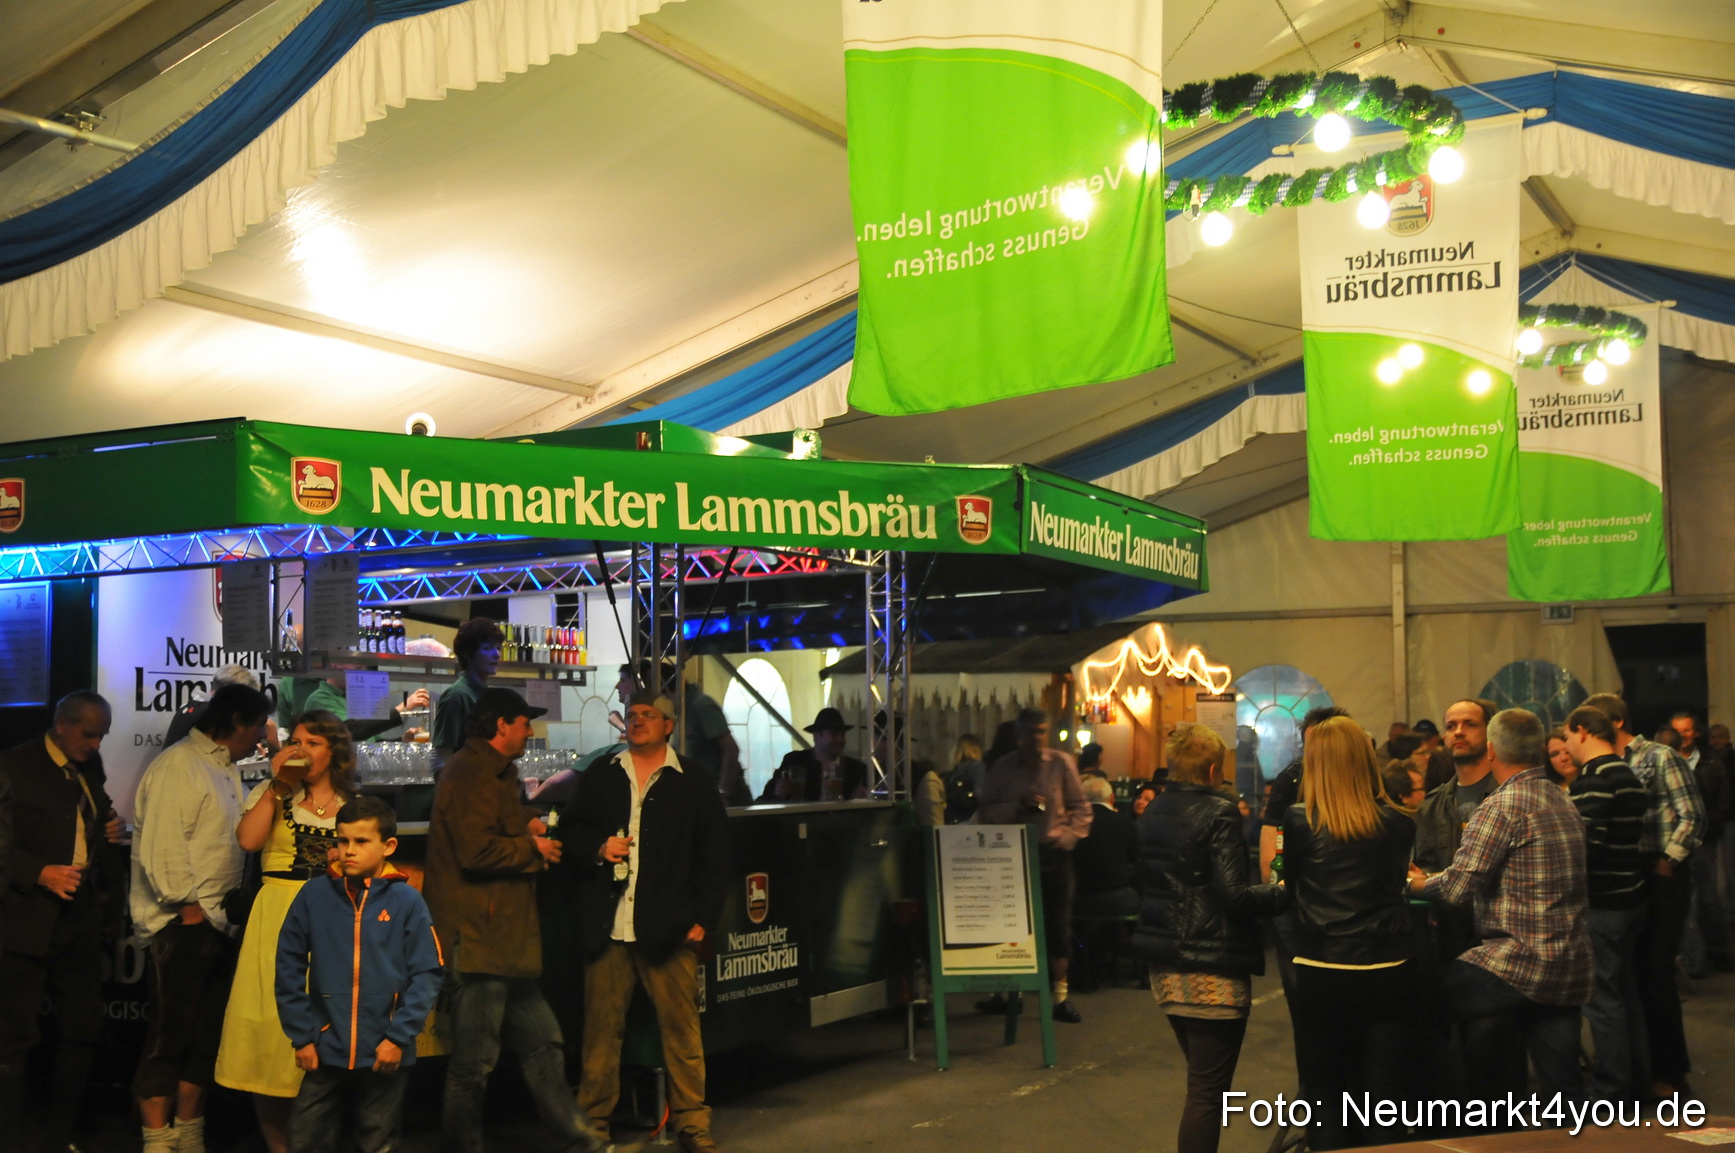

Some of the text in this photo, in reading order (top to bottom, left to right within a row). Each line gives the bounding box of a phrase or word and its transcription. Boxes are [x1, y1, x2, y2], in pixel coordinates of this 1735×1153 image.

[305, 498, 327, 509] 1628
[370, 466, 938, 540] Neumarkter Lammsbräu
[1029, 500, 1199, 580] Neumarkter Lammsbräu
[134, 733, 163, 747] DAS
[728, 925, 788, 951] Neumarkter
[716, 943, 798, 982] Lammsbräu
[717, 993, 730, 1003] DAS
[730, 988, 746, 1000] FEINE
[787, 977, 799, 988] BIER
